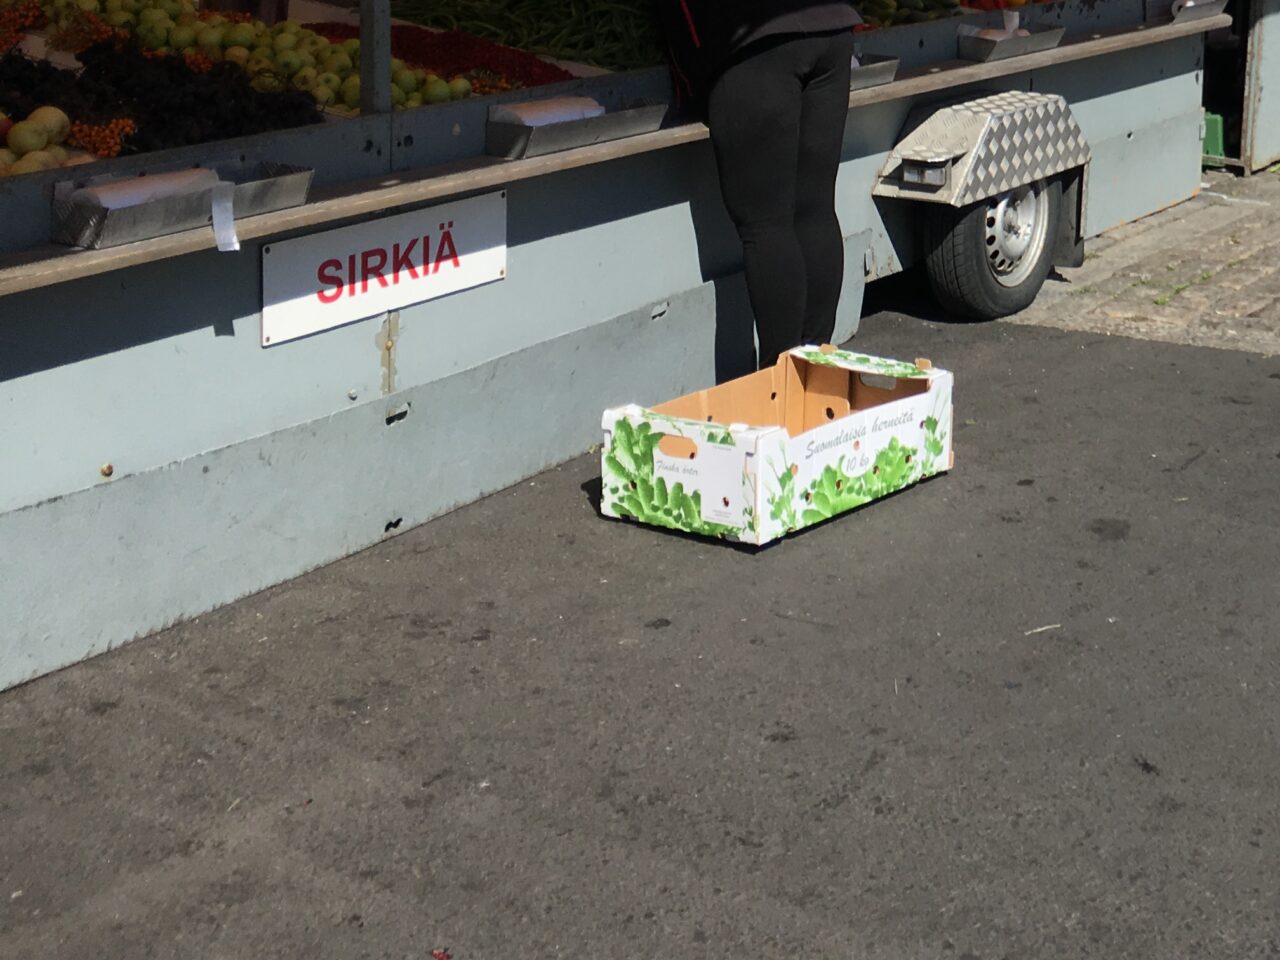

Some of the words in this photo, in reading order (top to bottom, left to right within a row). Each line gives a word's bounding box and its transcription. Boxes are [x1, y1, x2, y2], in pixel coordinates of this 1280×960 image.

[317, 221, 460, 304] SIRKIÄ
[805, 425, 867, 460] Suomalaisia
[871, 408, 915, 433] herneitä
